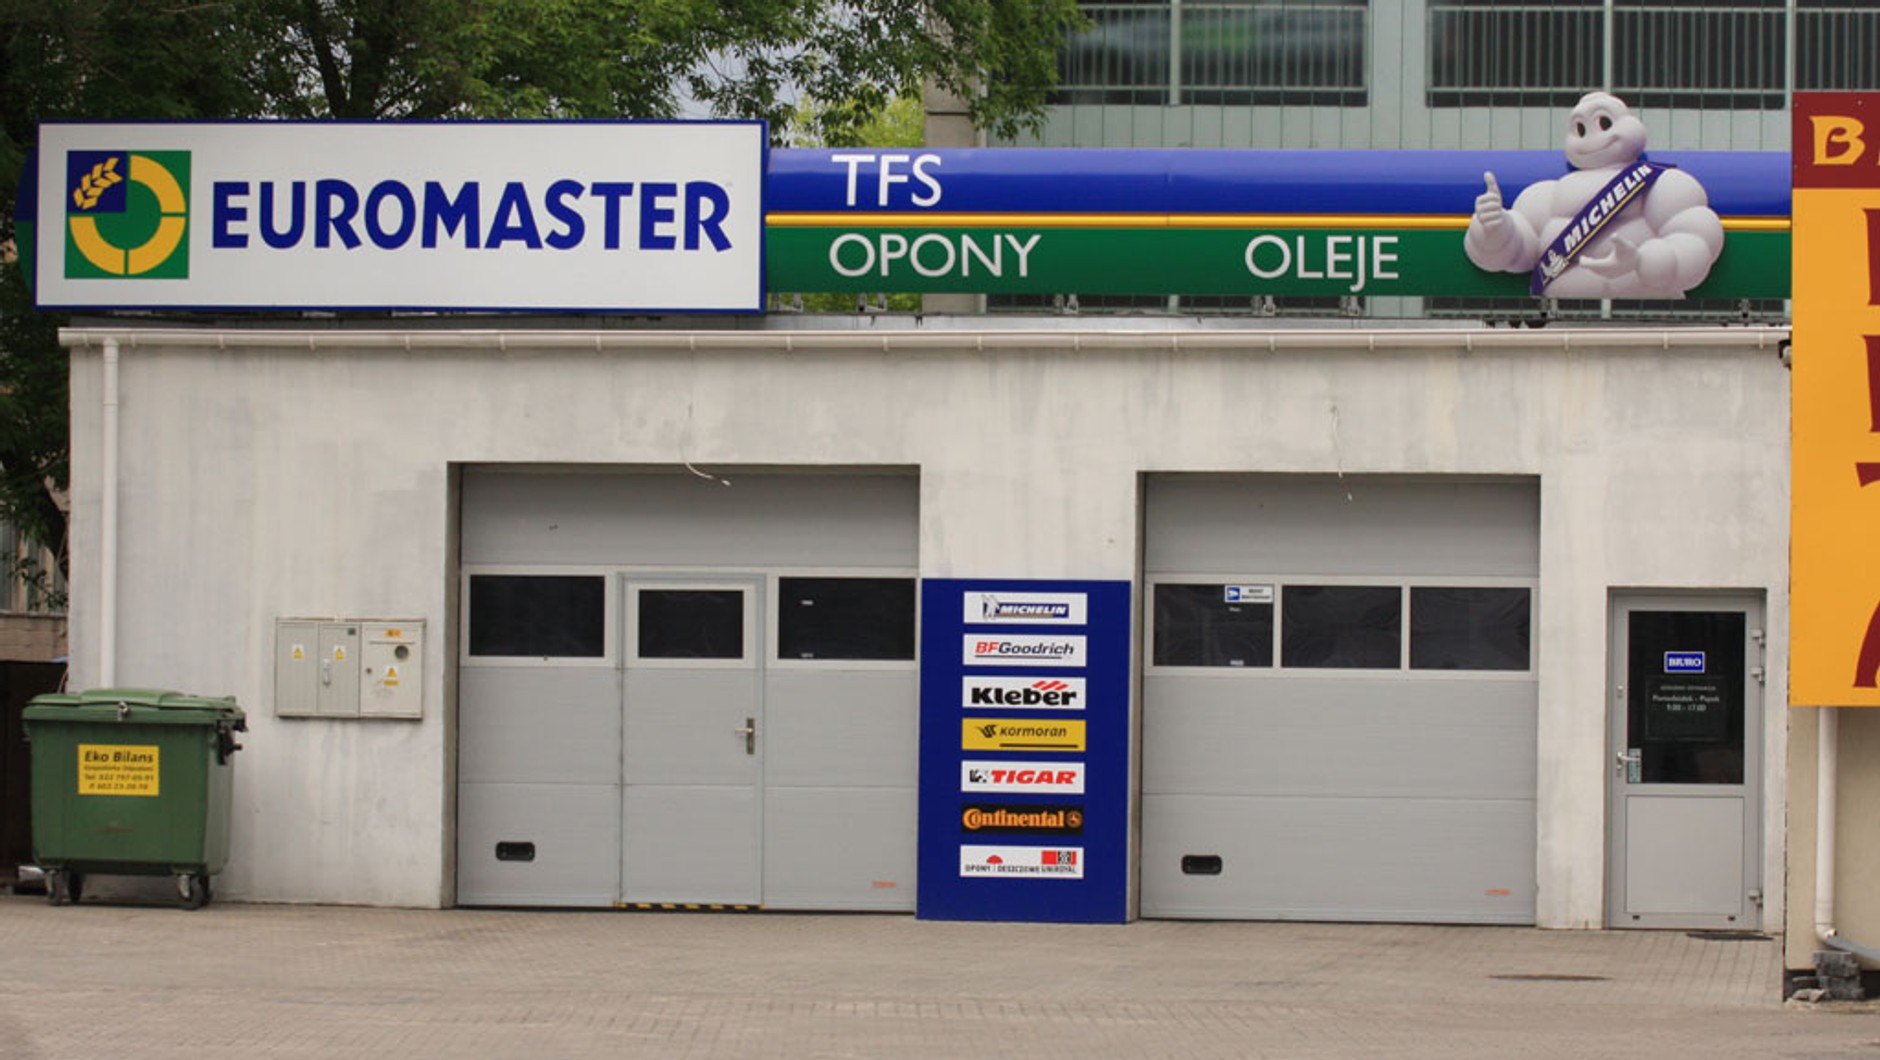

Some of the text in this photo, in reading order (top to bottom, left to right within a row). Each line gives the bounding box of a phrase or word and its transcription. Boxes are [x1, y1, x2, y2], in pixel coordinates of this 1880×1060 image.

[831, 153, 942, 207] TFS
[211, 178, 733, 253] EUROMASTER
[1563, 164, 1652, 253] MICHELIN
[828, 233, 1399, 292] OPONY OLEJE
[1000, 604, 1067, 615] MICHELIN
[975, 641, 1074, 655] BFGoodrich
[971, 687, 1077, 706] Kleber
[84, 750, 154, 763] Eko Bilans
[991, 769, 1077, 785] TIGAR
[962, 808, 1065, 830] Continental
